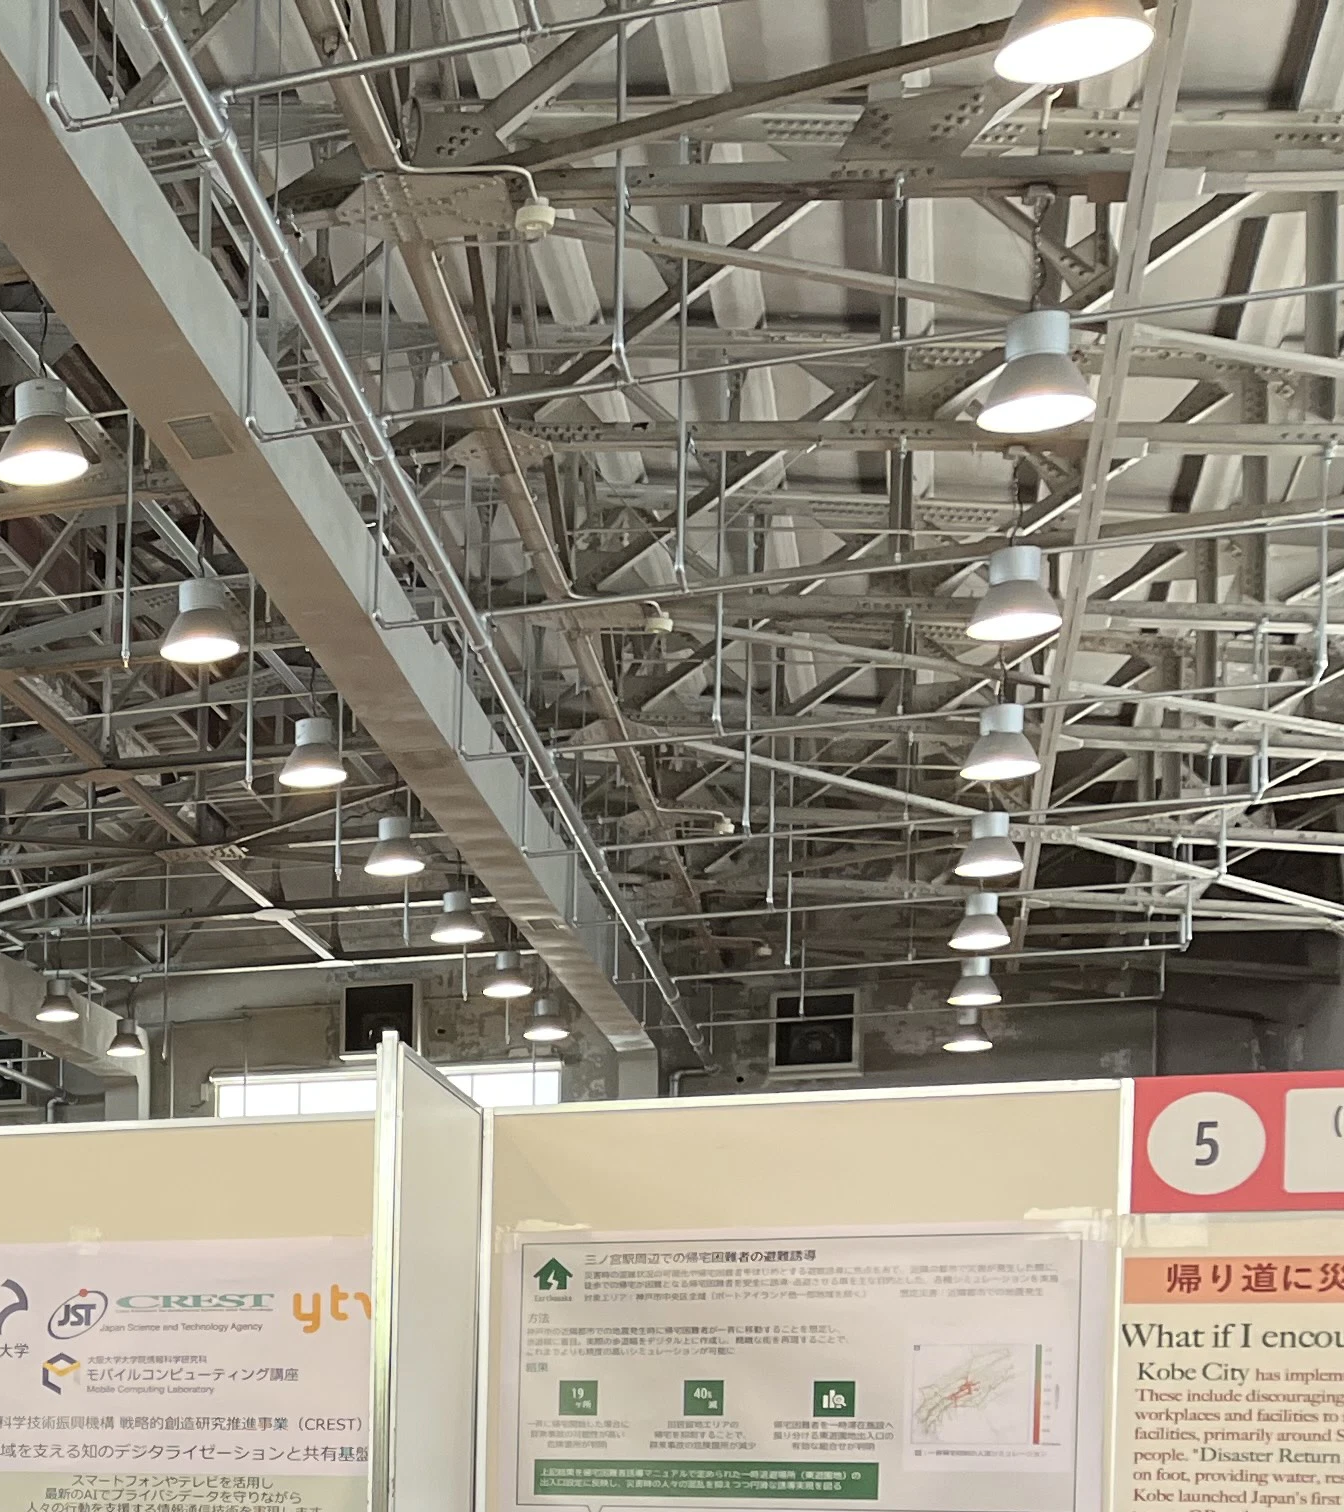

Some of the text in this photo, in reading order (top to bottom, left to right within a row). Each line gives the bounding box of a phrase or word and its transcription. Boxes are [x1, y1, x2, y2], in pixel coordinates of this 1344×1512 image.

[1195, 1121, 1219, 1166] 5
[116, 1293, 275, 1309] CREST
[58, 1303, 97, 1327] JST
[528, 1313, 550, 1324] 方法
[128, 1323, 160, 1331] Science
[163, 1323, 178, 1331] and
[181, 1322, 228, 1332] Technology
[230, 1322, 262, 1332] Agency
[1122, 1323, 1205, 1348] What
[1212, 1324, 1236, 1348] if
[1240, 1323, 1252, 1348] I
[87, 1367, 299, 1382] モバイルコンピューティング講座
[1137, 1362, 1280, 1386] Kobe City has
[571, 1388, 584, 1399] 19
[1135, 1389, 1183, 1402] These
[1187, 1389, 1243, 1402] include
[1135, 1409, 1339, 1424] workplaces and facilities to
[1135, 1428, 1331, 1445] facilities, primarily around
[1134, 1450, 1188, 1464] people.
[1279, 1448, 1340, 1463] Return
[72, 1475, 274, 1490] スマートフォンやテレビを活用し
[1133, 1469, 1320, 1485] on foot, providing water,
[1134, 1488, 1340, 1507] Kobe launched Japan's first
